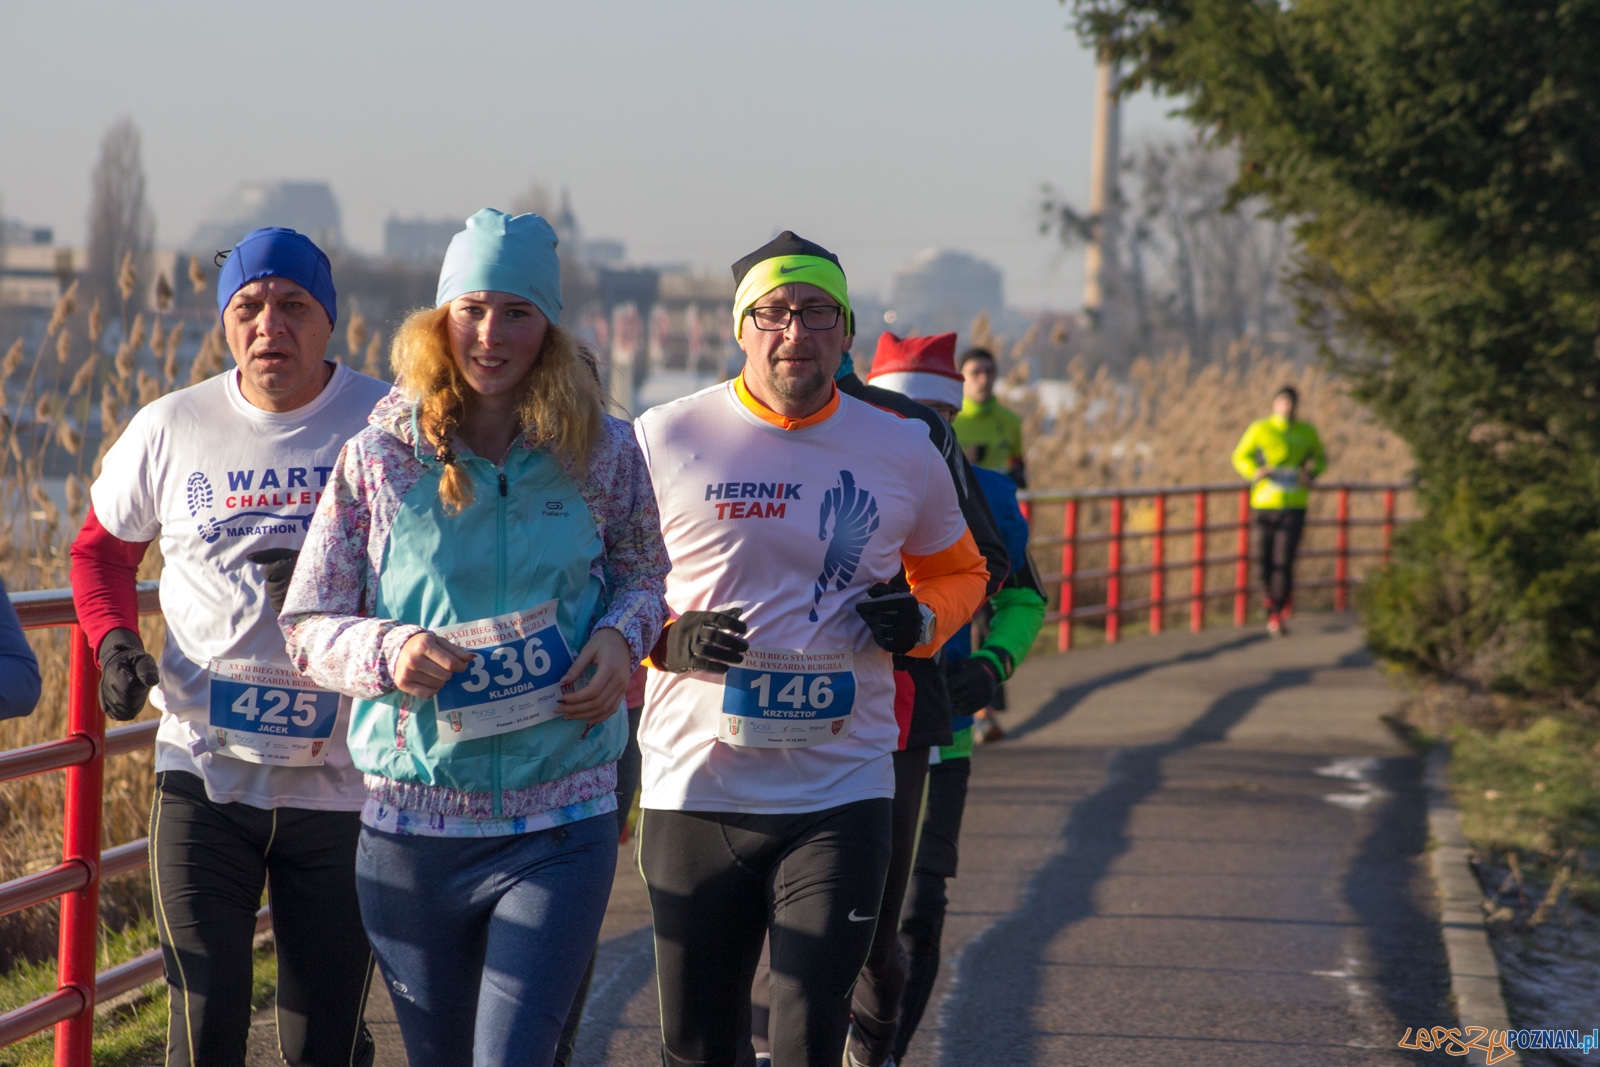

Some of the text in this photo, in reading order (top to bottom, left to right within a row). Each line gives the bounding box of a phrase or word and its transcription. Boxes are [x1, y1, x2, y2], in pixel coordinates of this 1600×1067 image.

[705, 483, 803, 501] HERNIK
[715, 502, 786, 521] TEAM
[226, 524, 297, 537] MARATHON
[470, 625, 491, 636] BIEG
[465, 631, 514, 648] RYSZARDA
[767, 652, 789, 661] BIEG
[790, 652, 846, 662] SYLWESTROWY
[228, 663, 251, 672] XXXII
[252, 666, 273, 675] BIEG
[461, 637, 552, 693] 336
[745, 659, 842, 671] IM. RYSZARDA BURGIELA
[230, 672, 243, 680] IM.
[245, 674, 290, 686] RYSZARDA
[488, 681, 535, 700] KLAUDIA
[750, 673, 834, 709] 146
[231, 686, 318, 727] 425
[763, 709, 817, 718] KRZYSZTOF
[257, 724, 289, 734] JACEK
